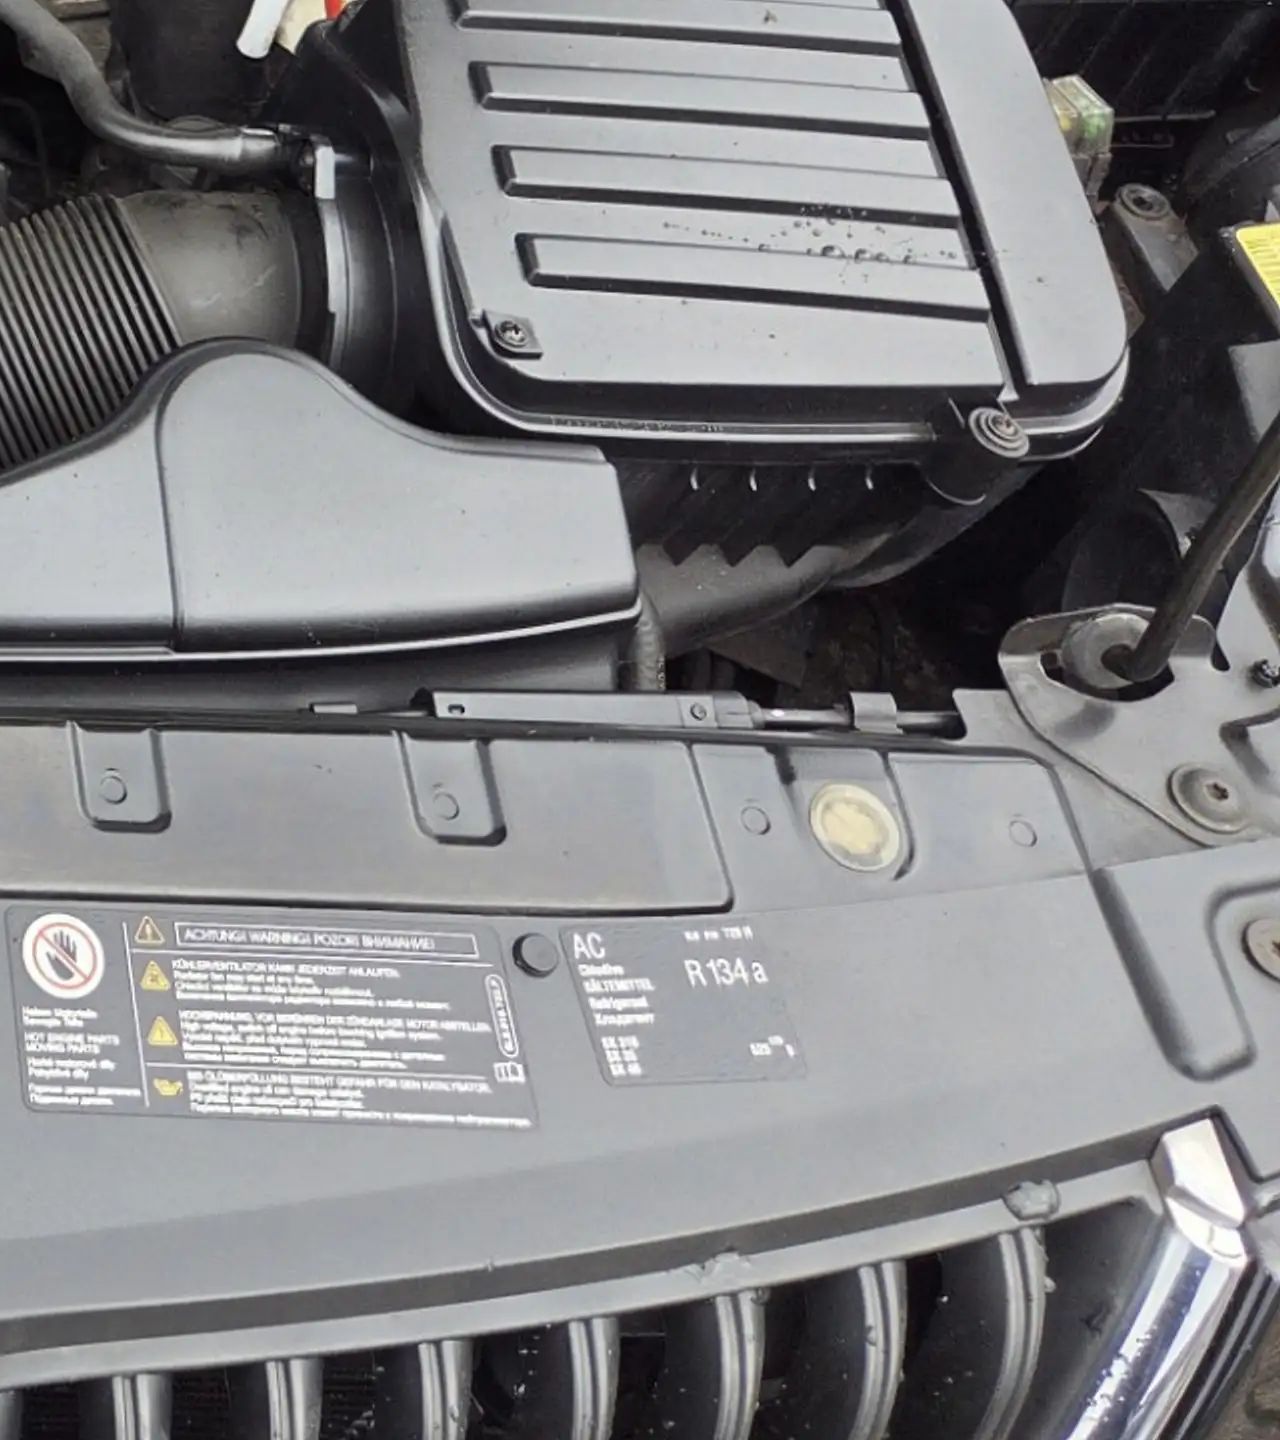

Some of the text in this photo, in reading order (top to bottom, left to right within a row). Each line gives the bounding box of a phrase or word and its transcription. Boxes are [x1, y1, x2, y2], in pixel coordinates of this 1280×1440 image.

[572, 932, 606, 960] AC
[684, 959, 707, 988] R
[751, 960, 769, 984] a
